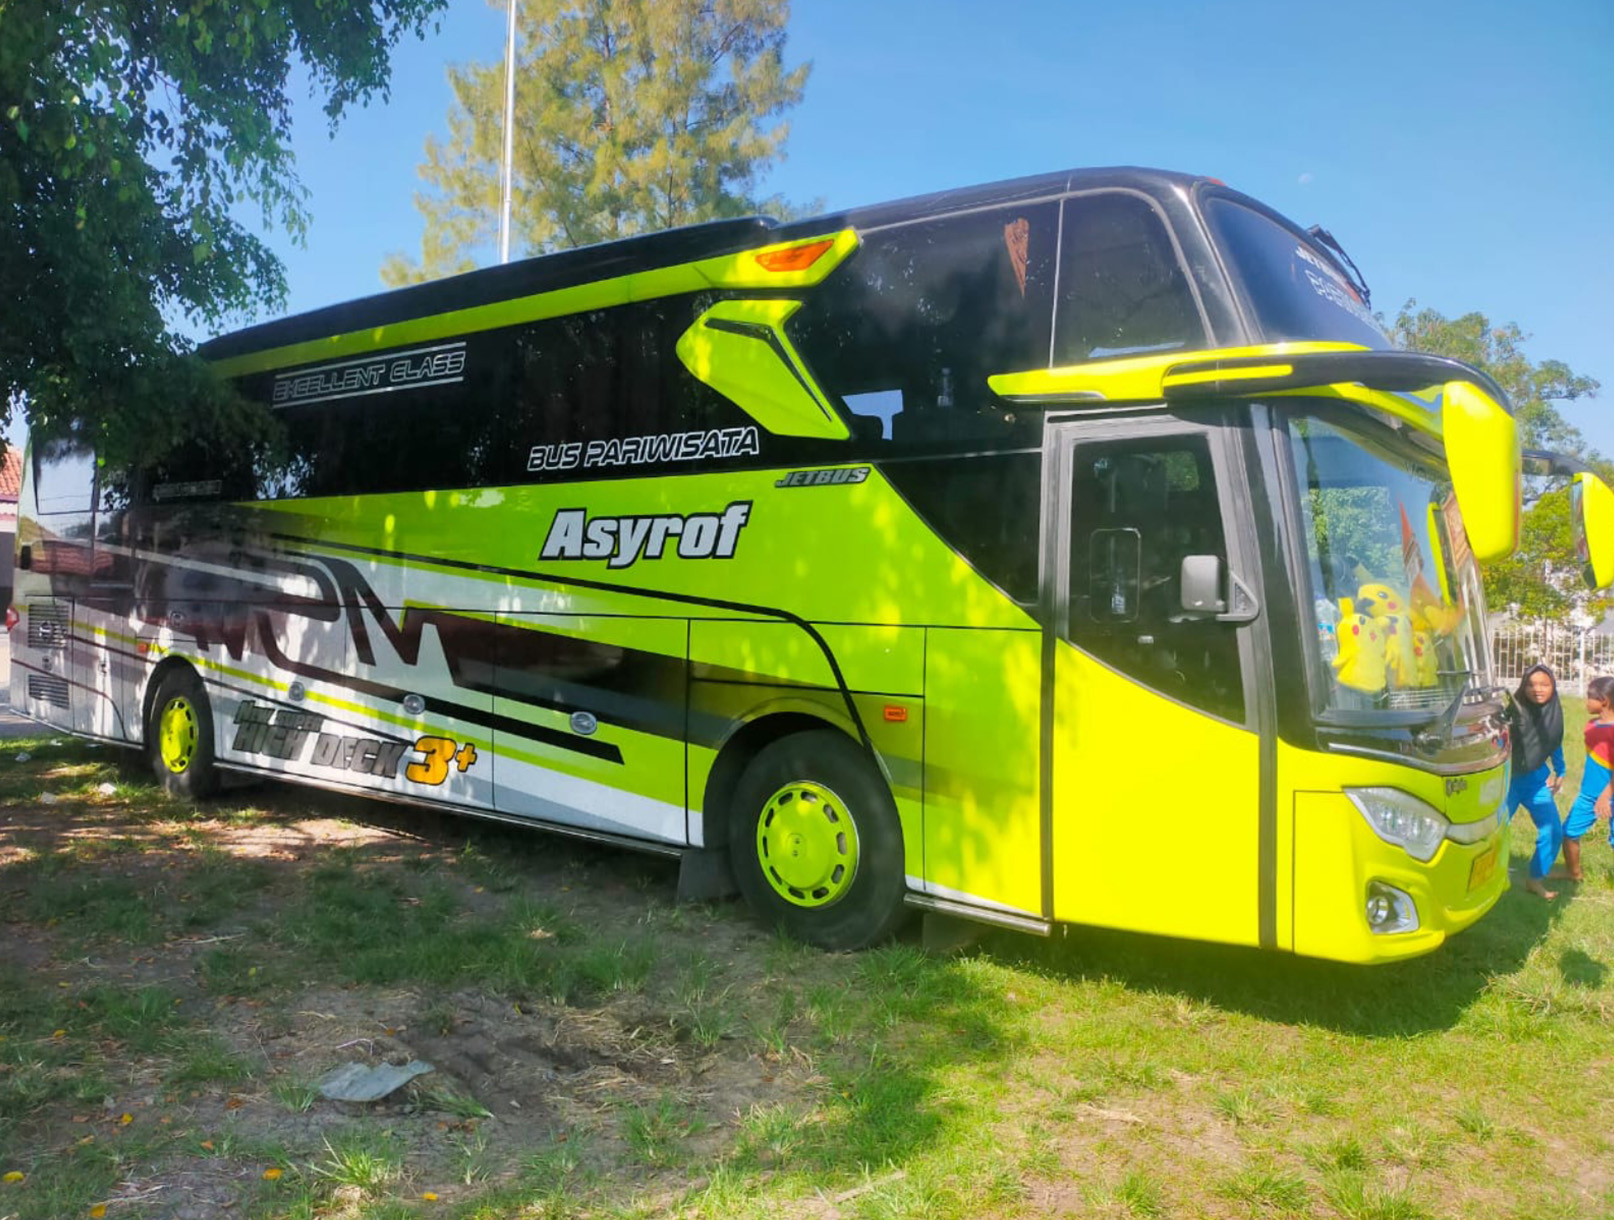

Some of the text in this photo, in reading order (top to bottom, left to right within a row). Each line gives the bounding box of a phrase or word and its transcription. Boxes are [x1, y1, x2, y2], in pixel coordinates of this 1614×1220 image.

[273, 351, 467, 401] EXCELLENT CLASS
[527, 426, 760, 471] BUS PARIWISATA
[775, 467, 871, 488] JETBUS
[539, 500, 753, 570] Asyrof
[232, 722, 308, 761] HIGH
[310, 733, 408, 779] DECK
